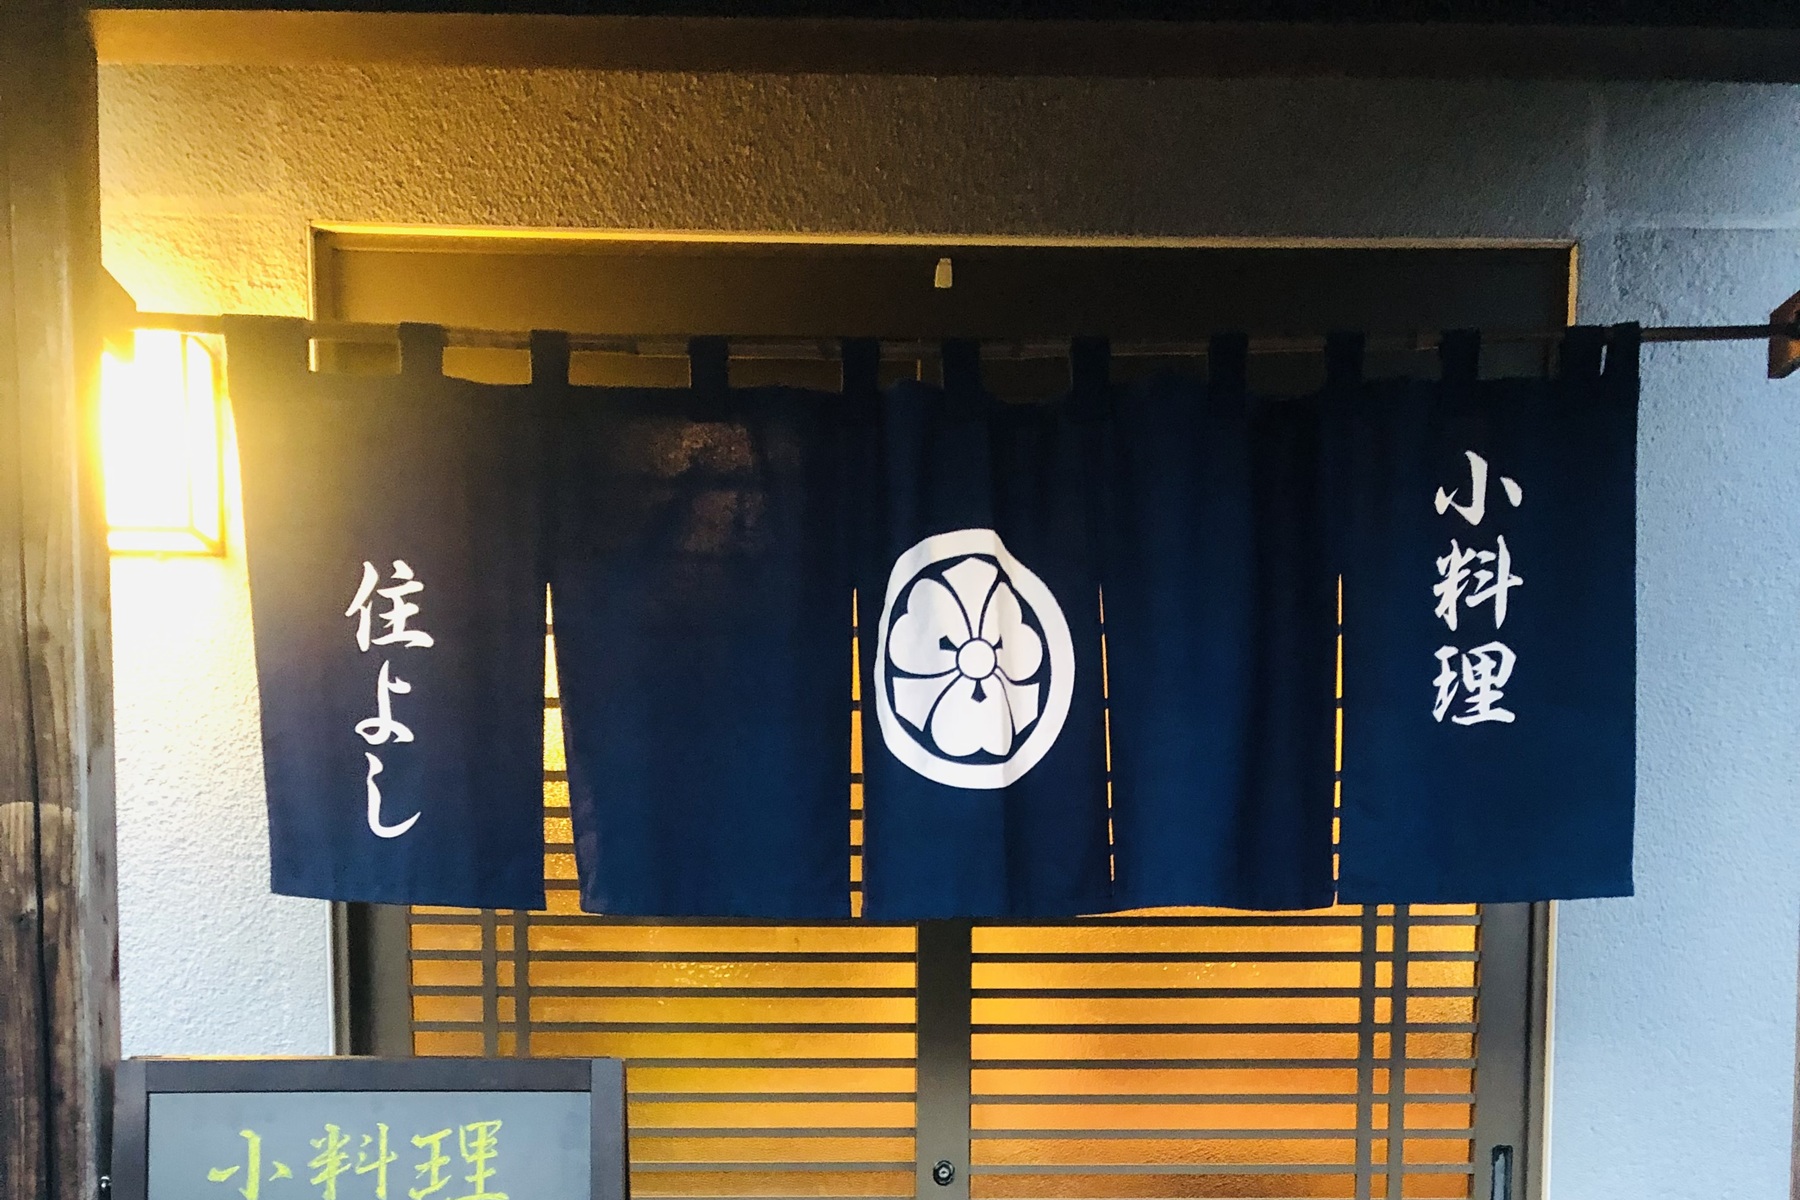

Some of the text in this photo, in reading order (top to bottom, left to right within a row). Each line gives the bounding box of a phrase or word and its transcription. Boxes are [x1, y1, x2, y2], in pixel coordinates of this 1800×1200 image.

[345, 559, 434, 838] 住よし
[1431, 450, 1524, 725] 小料理
